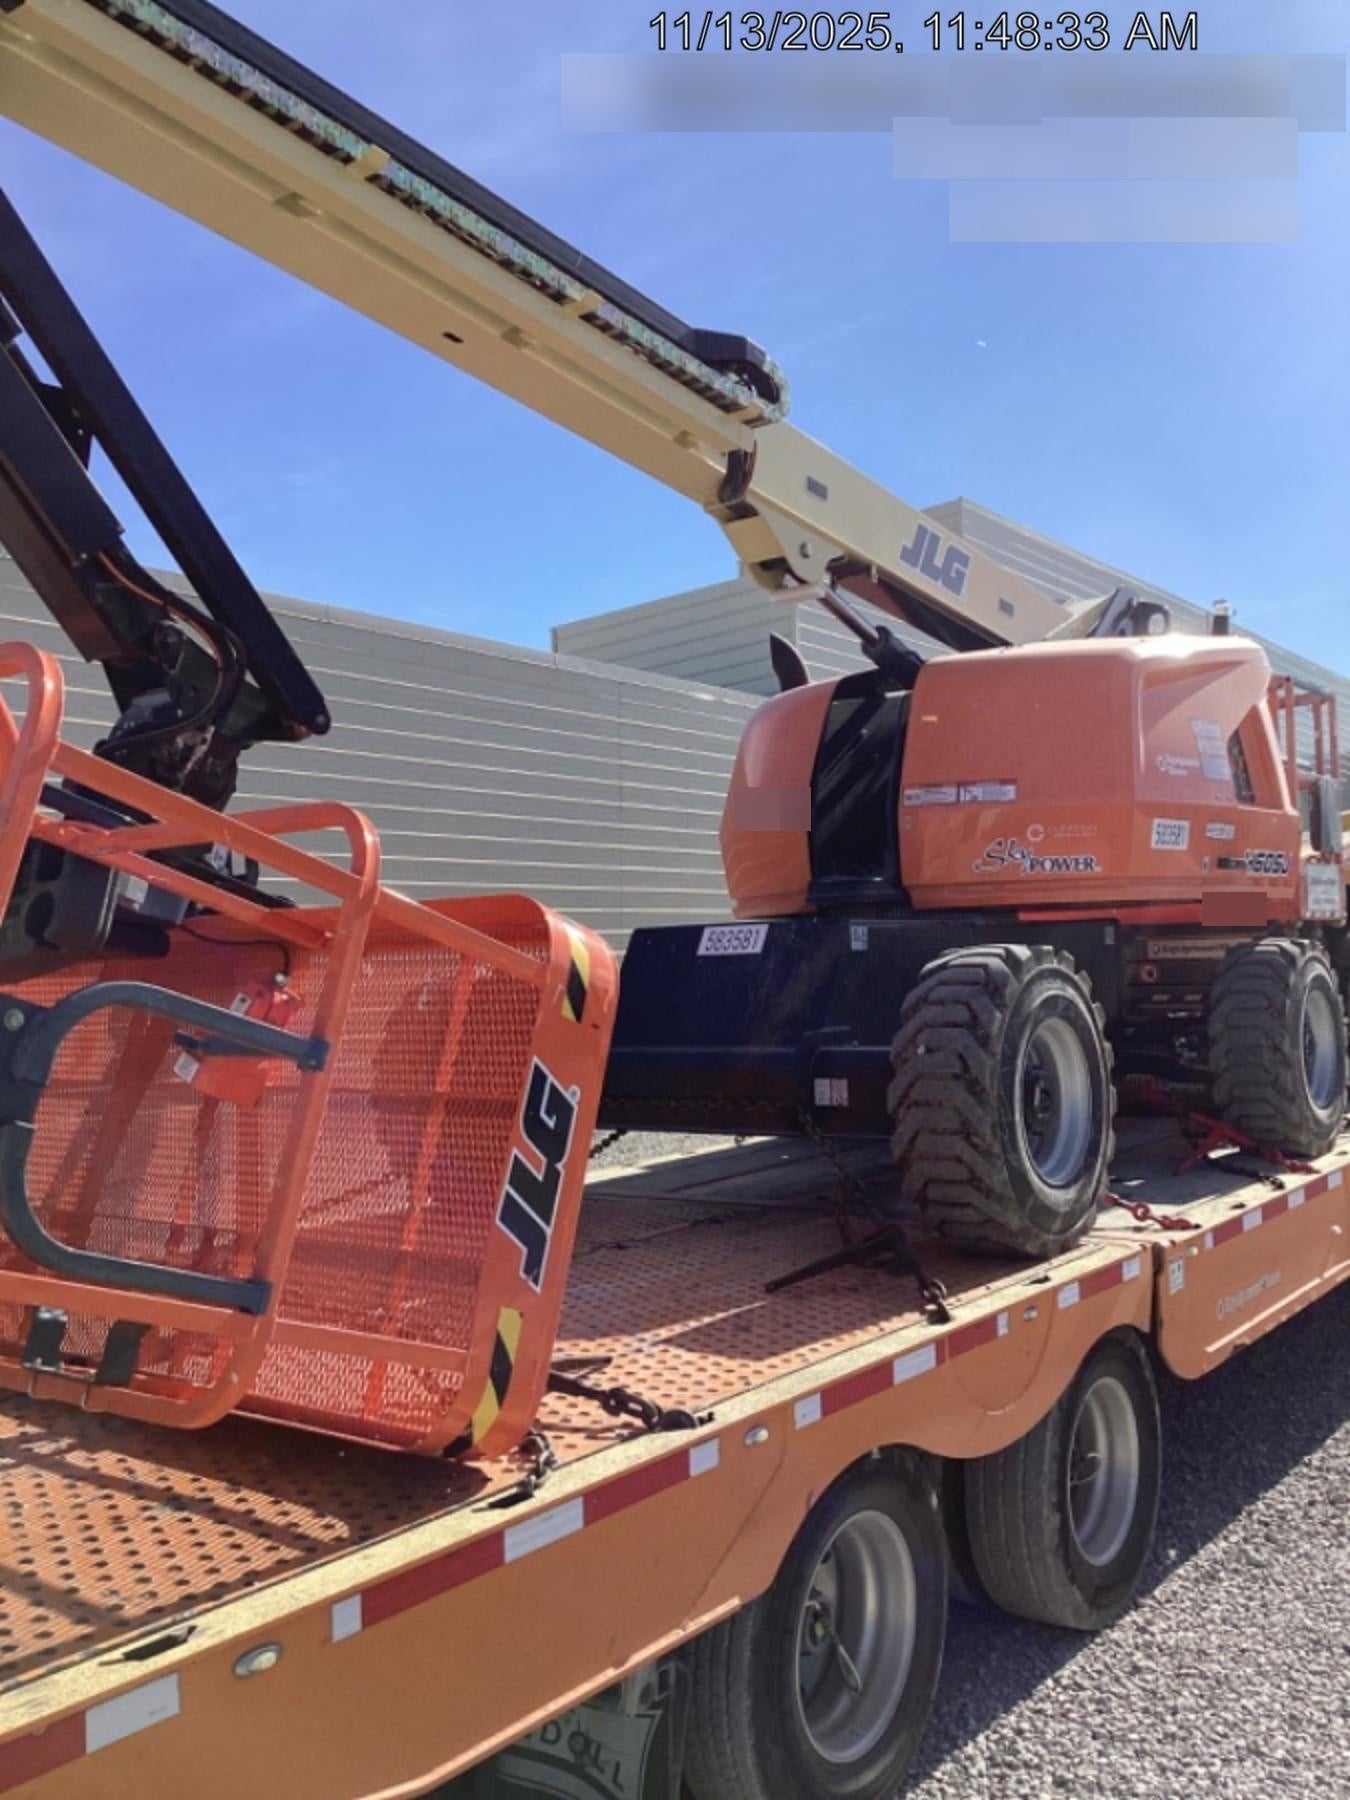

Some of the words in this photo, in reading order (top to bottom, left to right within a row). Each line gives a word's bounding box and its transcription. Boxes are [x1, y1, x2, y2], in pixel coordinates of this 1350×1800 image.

[899, 521, 972, 598] JLG
[971, 837, 1034, 876] Sky
[1029, 855, 1097, 873] POWER
[496, 1055, 577, 1294] JLG
